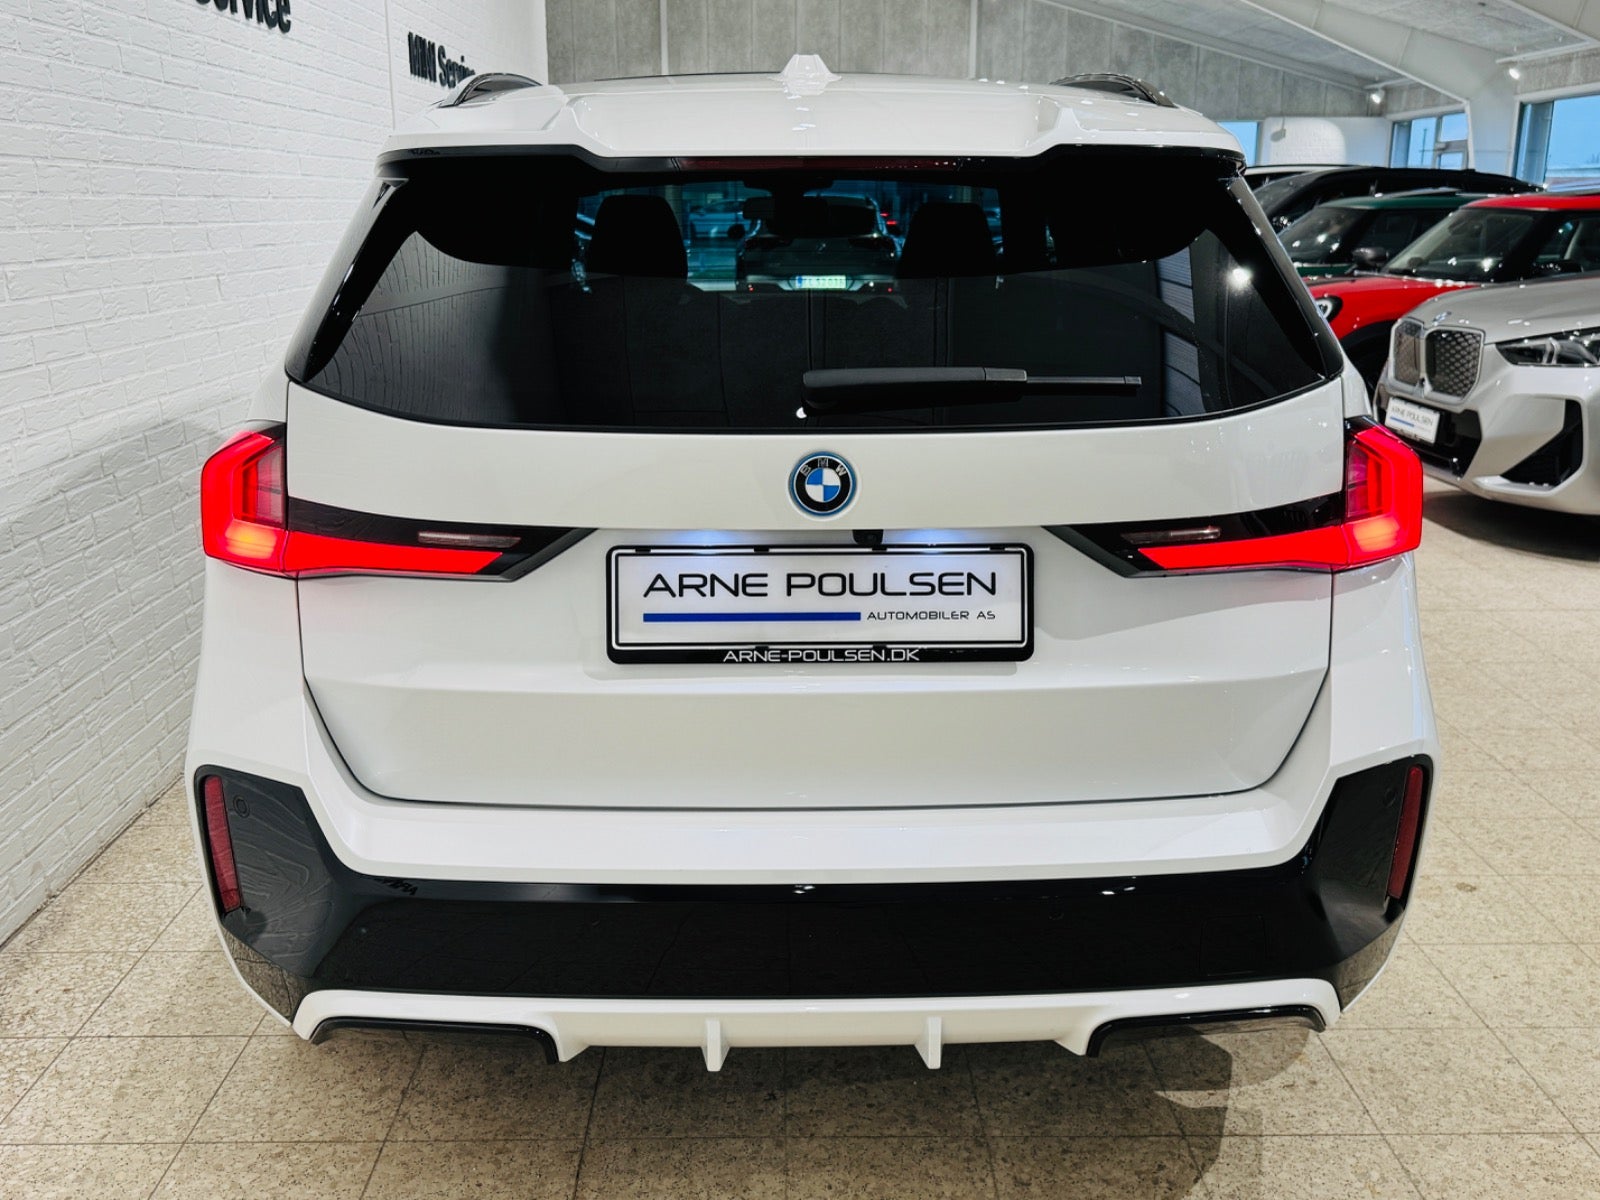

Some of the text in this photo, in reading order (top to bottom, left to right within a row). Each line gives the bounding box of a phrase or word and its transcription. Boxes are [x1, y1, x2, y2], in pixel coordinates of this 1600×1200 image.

[408, 31, 475, 89] MINI Servi
[643, 572, 996, 598] ARNE POULSEN
[867, 611, 996, 620] AUTOMOBILER AS
[723, 649, 920, 663] ARNE-POULSEN.DK
